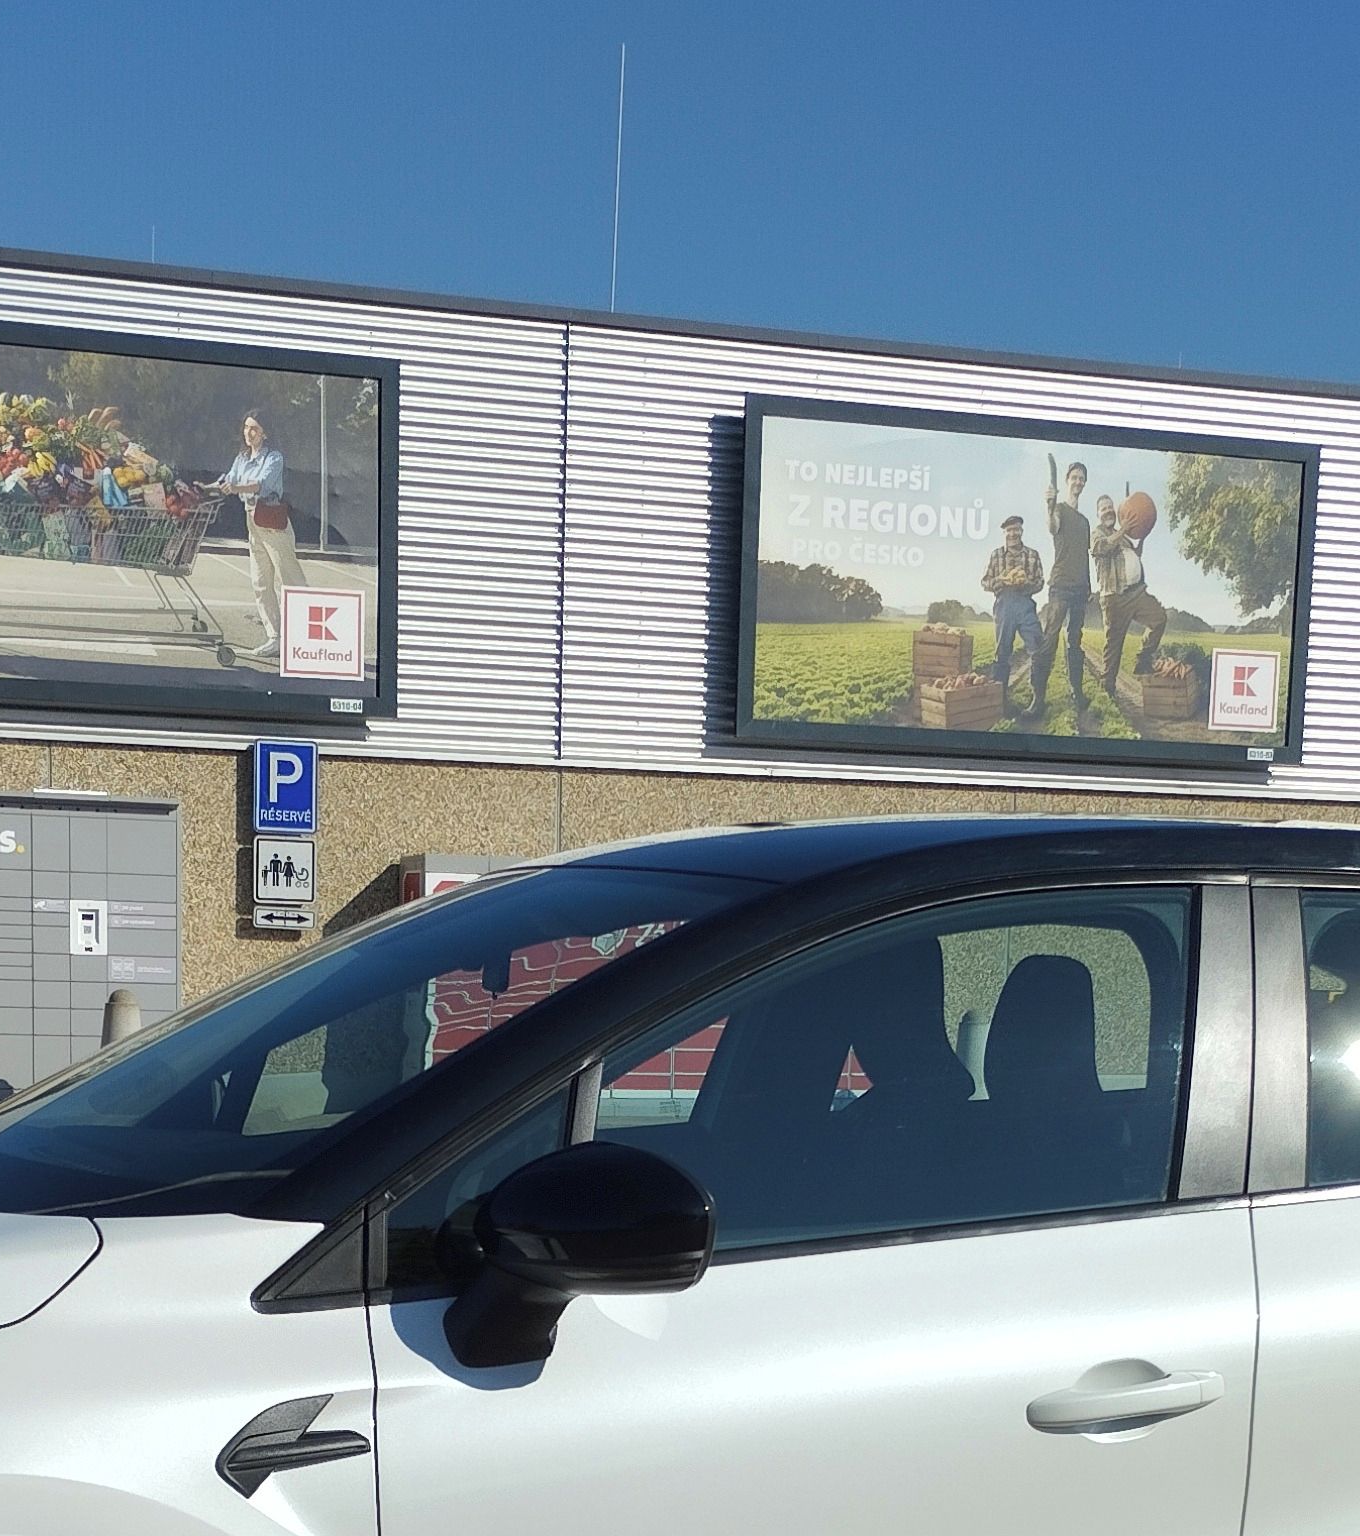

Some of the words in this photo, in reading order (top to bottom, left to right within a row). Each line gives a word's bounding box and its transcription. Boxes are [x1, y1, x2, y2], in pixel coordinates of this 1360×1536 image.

[785, 458, 818, 483] TO
[824, 461, 931, 491] NEJLEPŠÍ
[787, 493, 812, 528] Z
[824, 497, 991, 540] REGIONŮ
[791, 537, 841, 564] PRO
[848, 535, 925, 567] ČESKO
[292, 646, 353, 662] Kaufland
[1219, 702, 1268, 716] Kaufland
[269, 751, 303, 803] P
[260, 807, 311, 823] RÉSERVÉ
